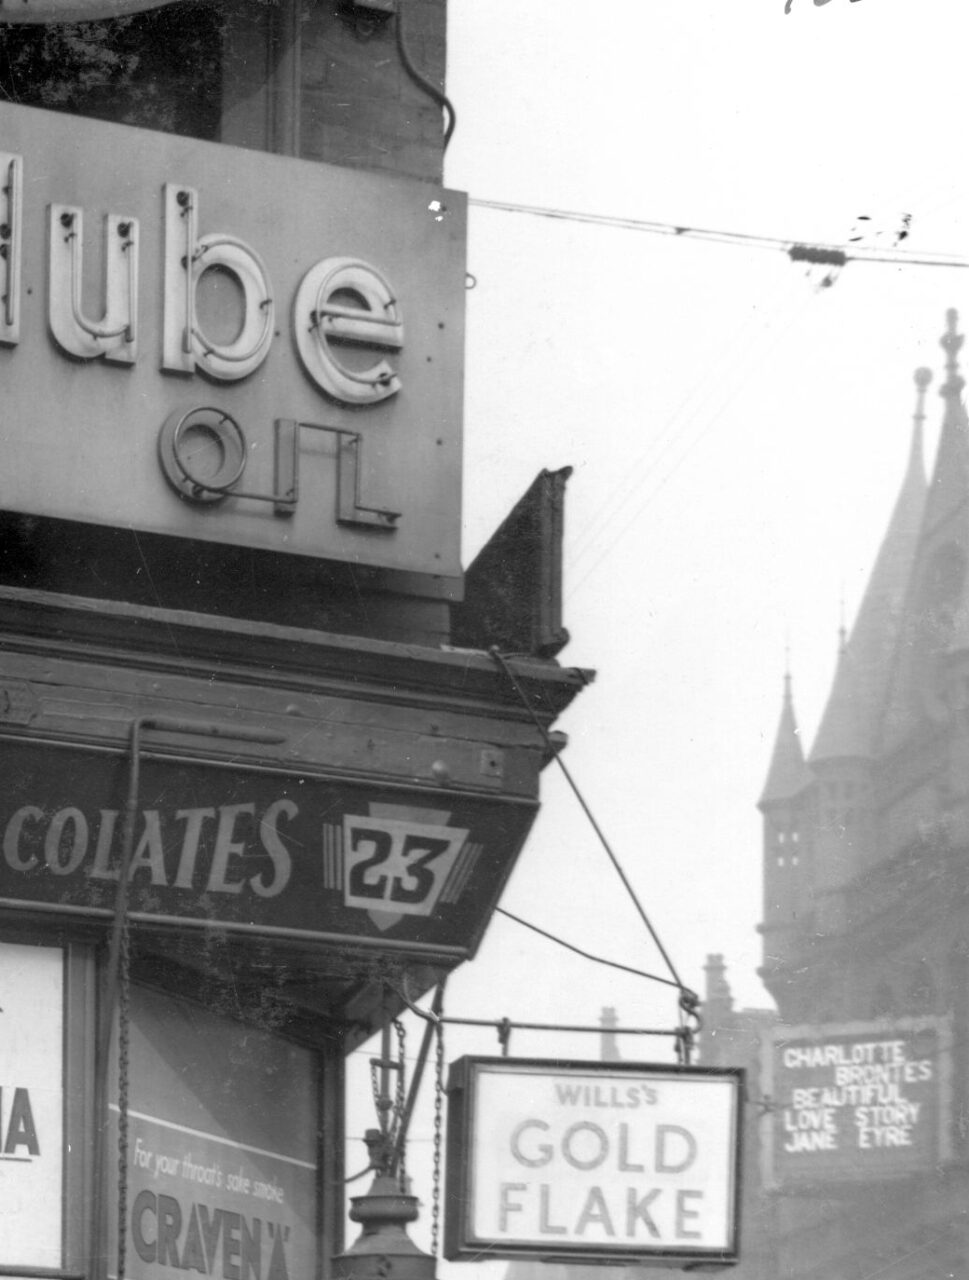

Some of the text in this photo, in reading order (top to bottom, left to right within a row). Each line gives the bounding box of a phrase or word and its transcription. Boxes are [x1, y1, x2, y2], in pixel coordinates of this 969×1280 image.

[158, 406, 402, 530] OIL
[349, 826, 452, 906] 23
[783, 1040, 906, 1069] CHARLOTTE
[784, 1102, 921, 1132] LOVE STORY
[792, 1083, 908, 1110] BEAUTIFUL
[509, 1118, 698, 1174] GOLD
[784, 1124, 913, 1153] JANE EYRE
[498, 1181, 704, 1240] FLAKE
